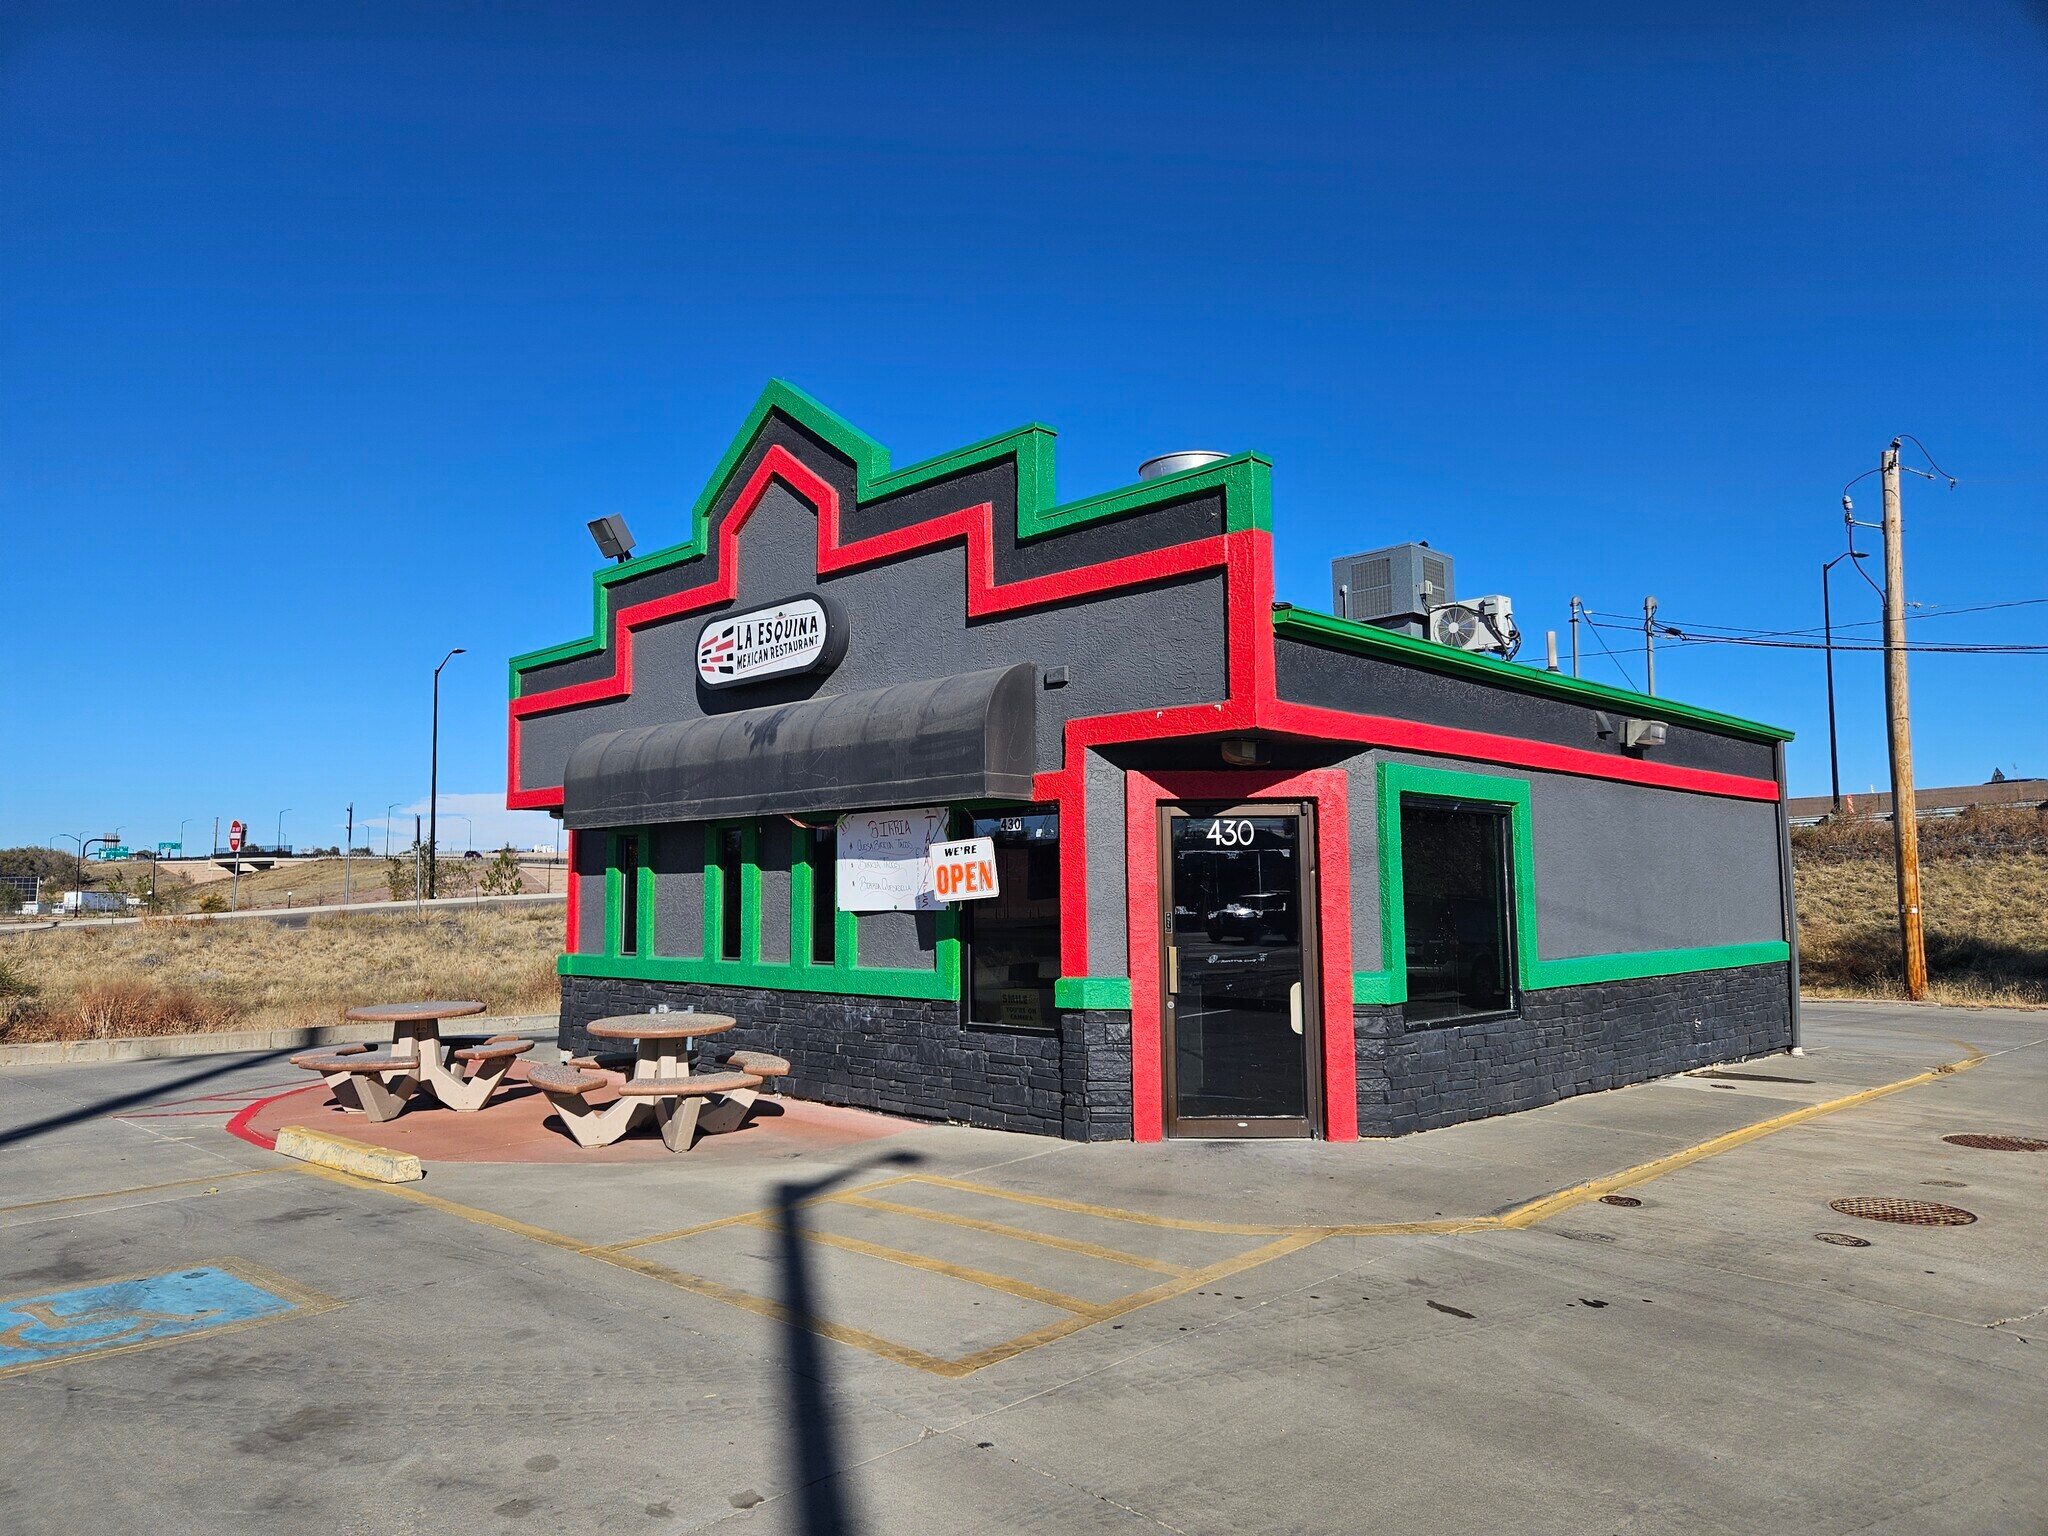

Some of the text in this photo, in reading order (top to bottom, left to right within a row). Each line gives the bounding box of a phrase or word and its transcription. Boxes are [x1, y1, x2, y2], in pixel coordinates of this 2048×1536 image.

[737, 616, 818, 650] LA ESQUINA
[737, 635, 819, 670] MEXICAN RESTAURANT
[868, 819, 912, 838] BIRRIA
[1000, 818, 1021, 831] 430
[1206, 819, 1255, 845] 430
[944, 844, 977, 857] WE'RE
[936, 859, 993, 895] OPEN
[1002, 994, 1028, 1005] SMILE
